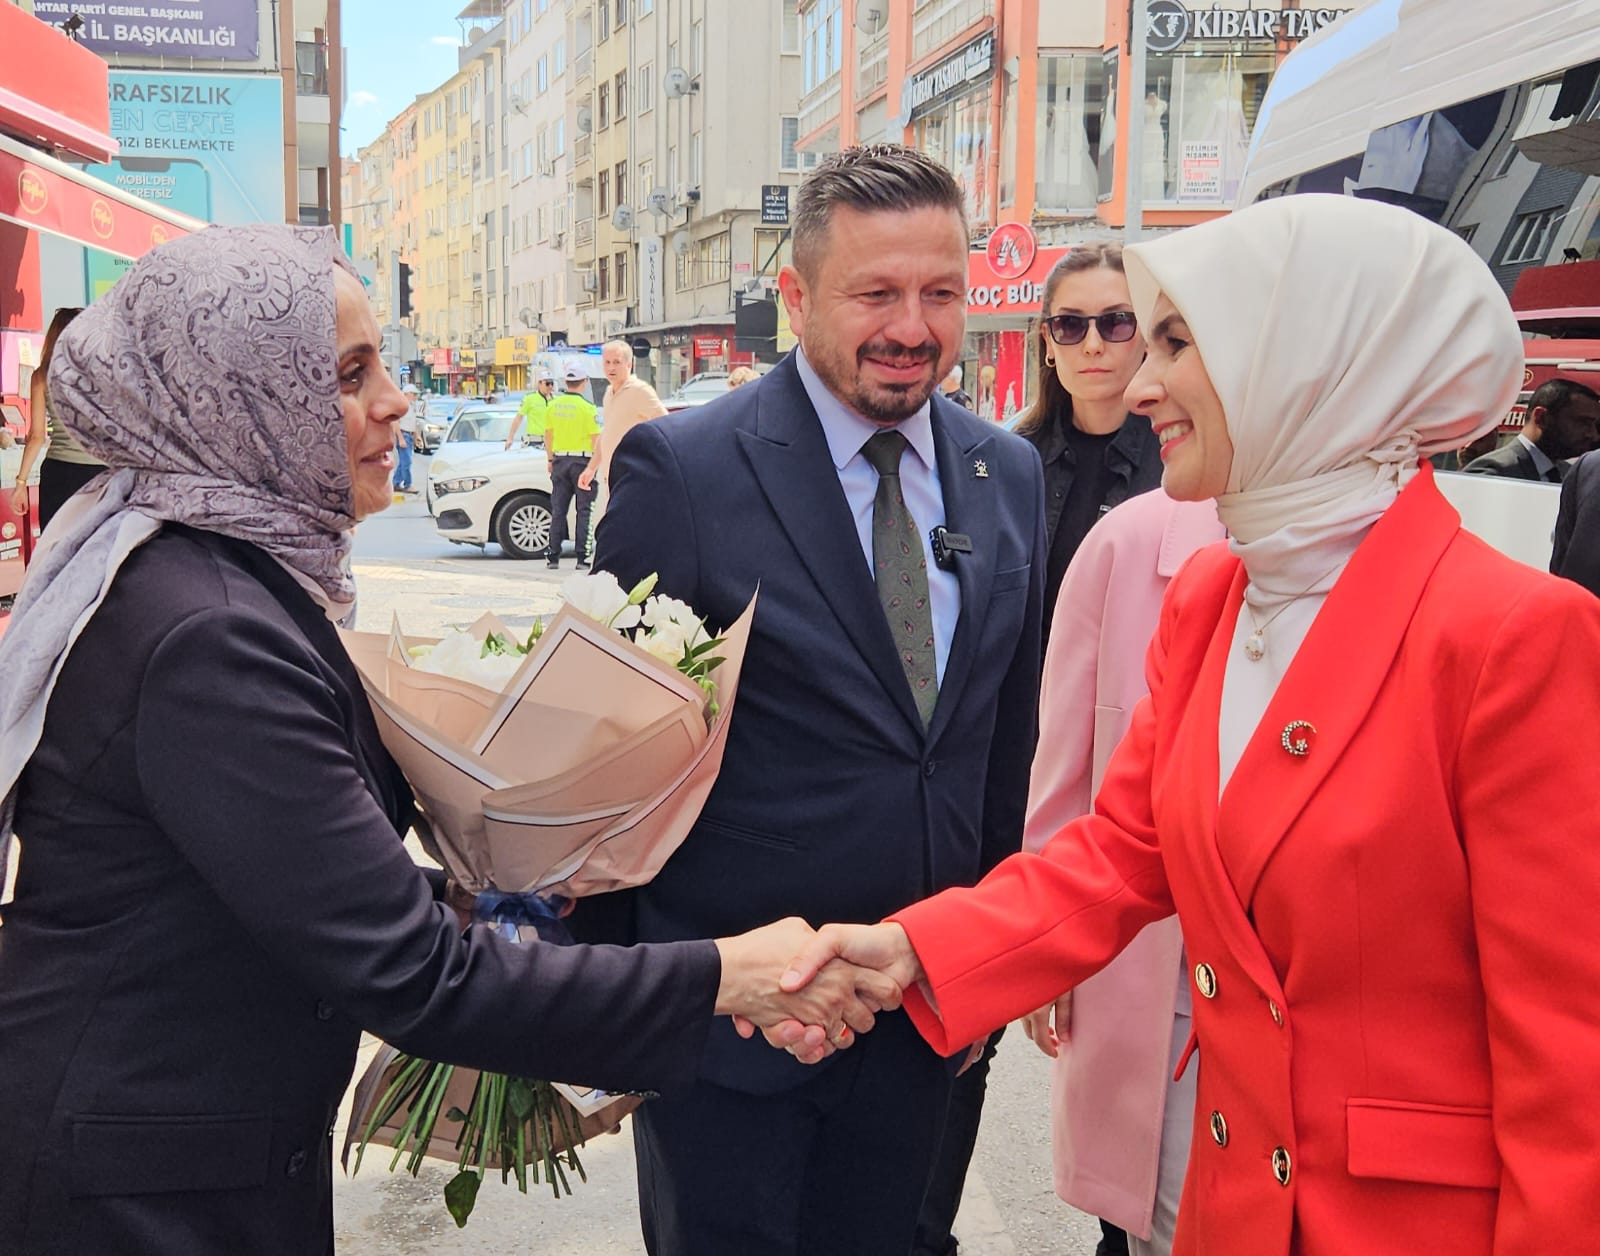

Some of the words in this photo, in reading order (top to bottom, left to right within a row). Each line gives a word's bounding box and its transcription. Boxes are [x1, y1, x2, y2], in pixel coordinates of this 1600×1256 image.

[108, 6, 148, 17] GENEL
[150, 8, 203, 20] BAŞKANI
[1193, 2, 1275, 38] KİBAR
[91, 20, 110, 40] İL
[114, 25, 236, 47] BAŞKANLIĞI
[109, 83, 232, 106] RAFSIZLIK
[153, 110, 236, 135] CEPTE
[144, 138, 236, 152] BEKLEMEKTE
